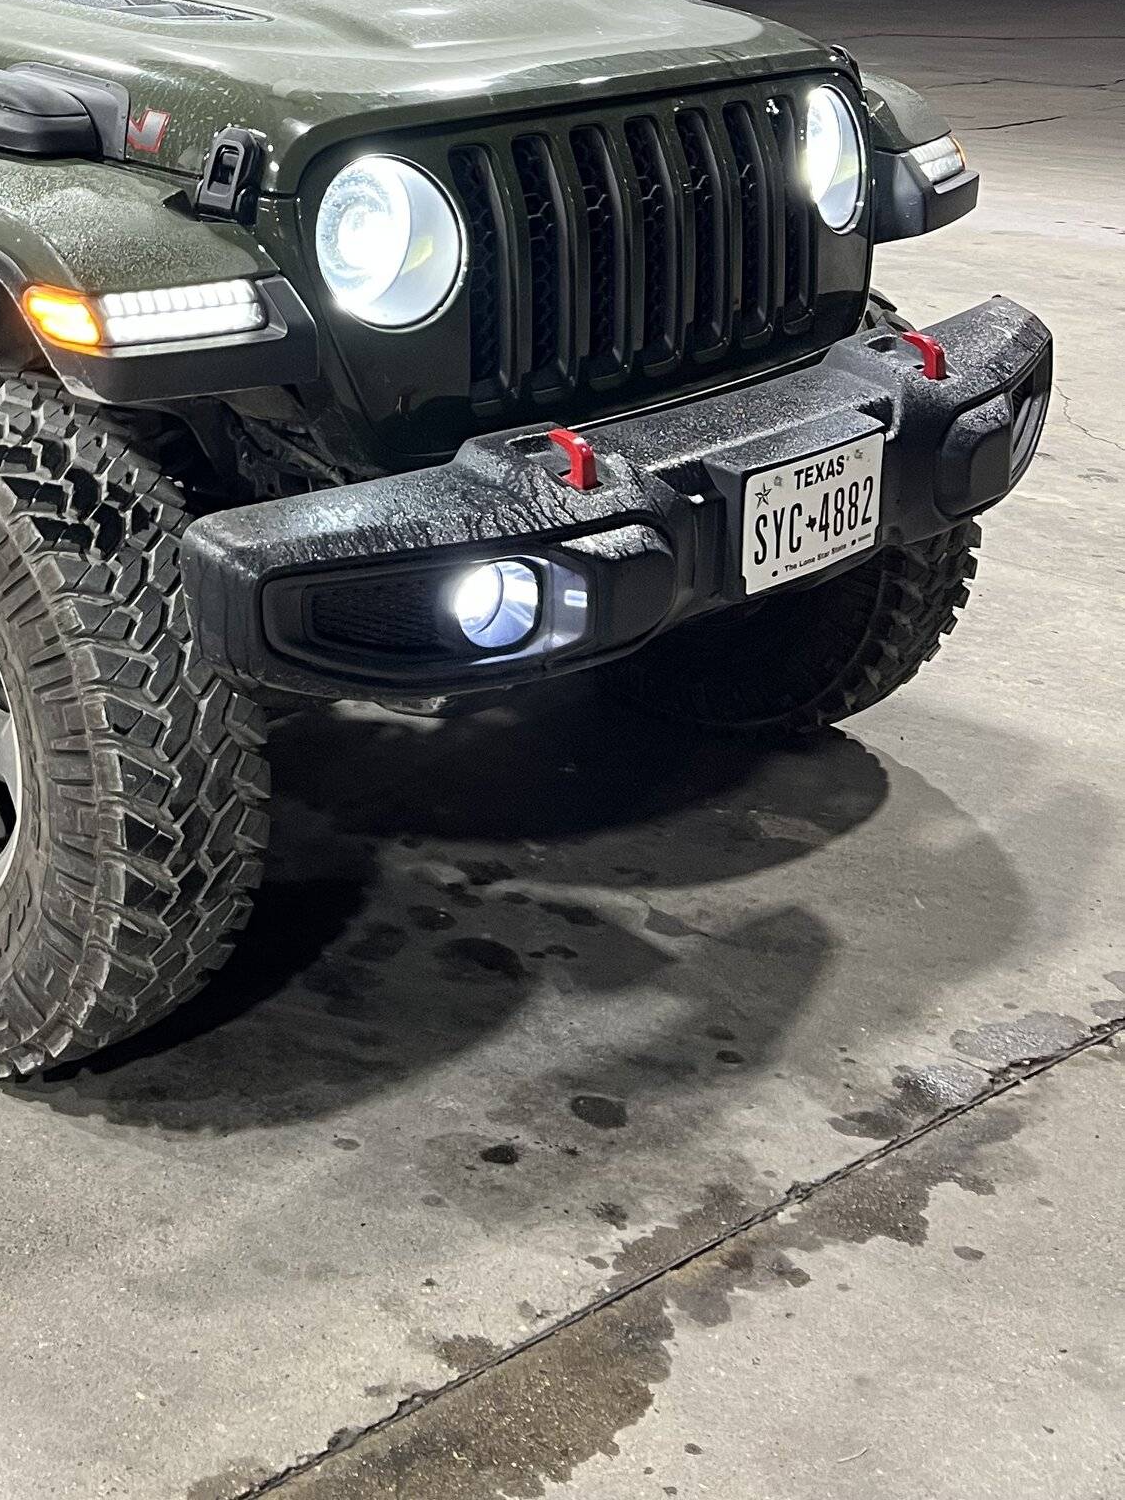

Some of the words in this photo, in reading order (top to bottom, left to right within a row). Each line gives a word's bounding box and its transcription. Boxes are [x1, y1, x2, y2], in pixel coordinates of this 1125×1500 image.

[794, 454, 845, 490] TEXAS
[784, 562, 797, 572] The
[799, 556, 816, 567] Lone
[817, 551, 830, 561] Star
[832, 544, 847, 555] State
